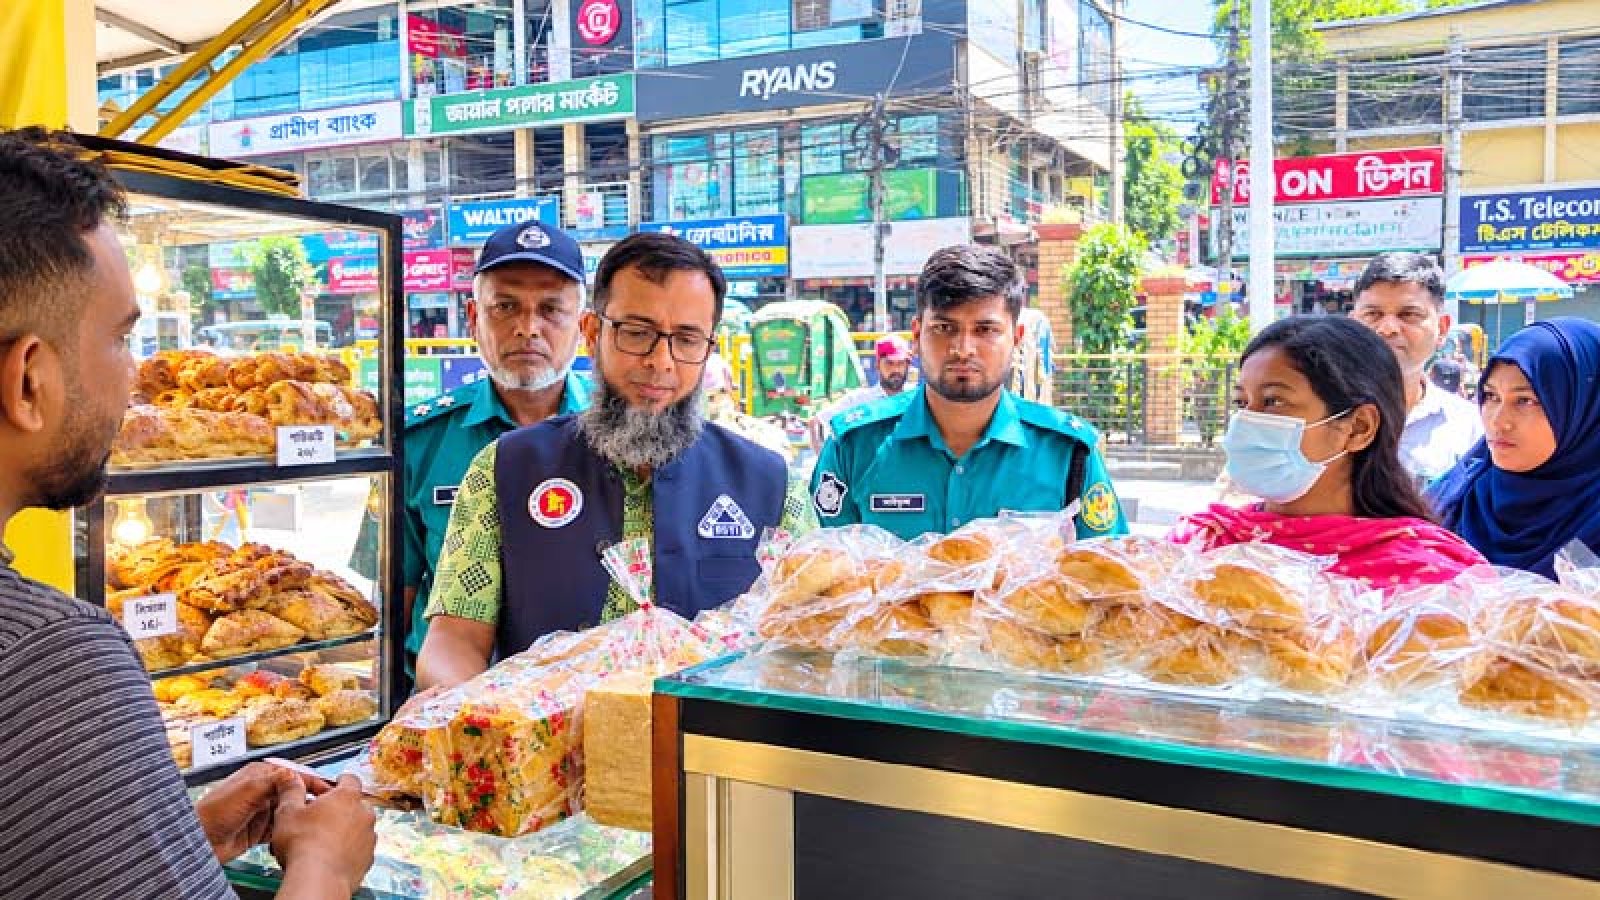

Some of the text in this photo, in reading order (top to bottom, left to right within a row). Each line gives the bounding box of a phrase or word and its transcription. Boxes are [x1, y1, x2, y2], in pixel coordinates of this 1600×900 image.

[739, 61, 837, 100] RYANS
[559, 81, 619, 110] মার্কেট
[270, 112, 377, 140] গ্রামীণ ব্যাংক
[463, 206, 541, 227] WALTON
[1473, 199, 1517, 222] T.S.
